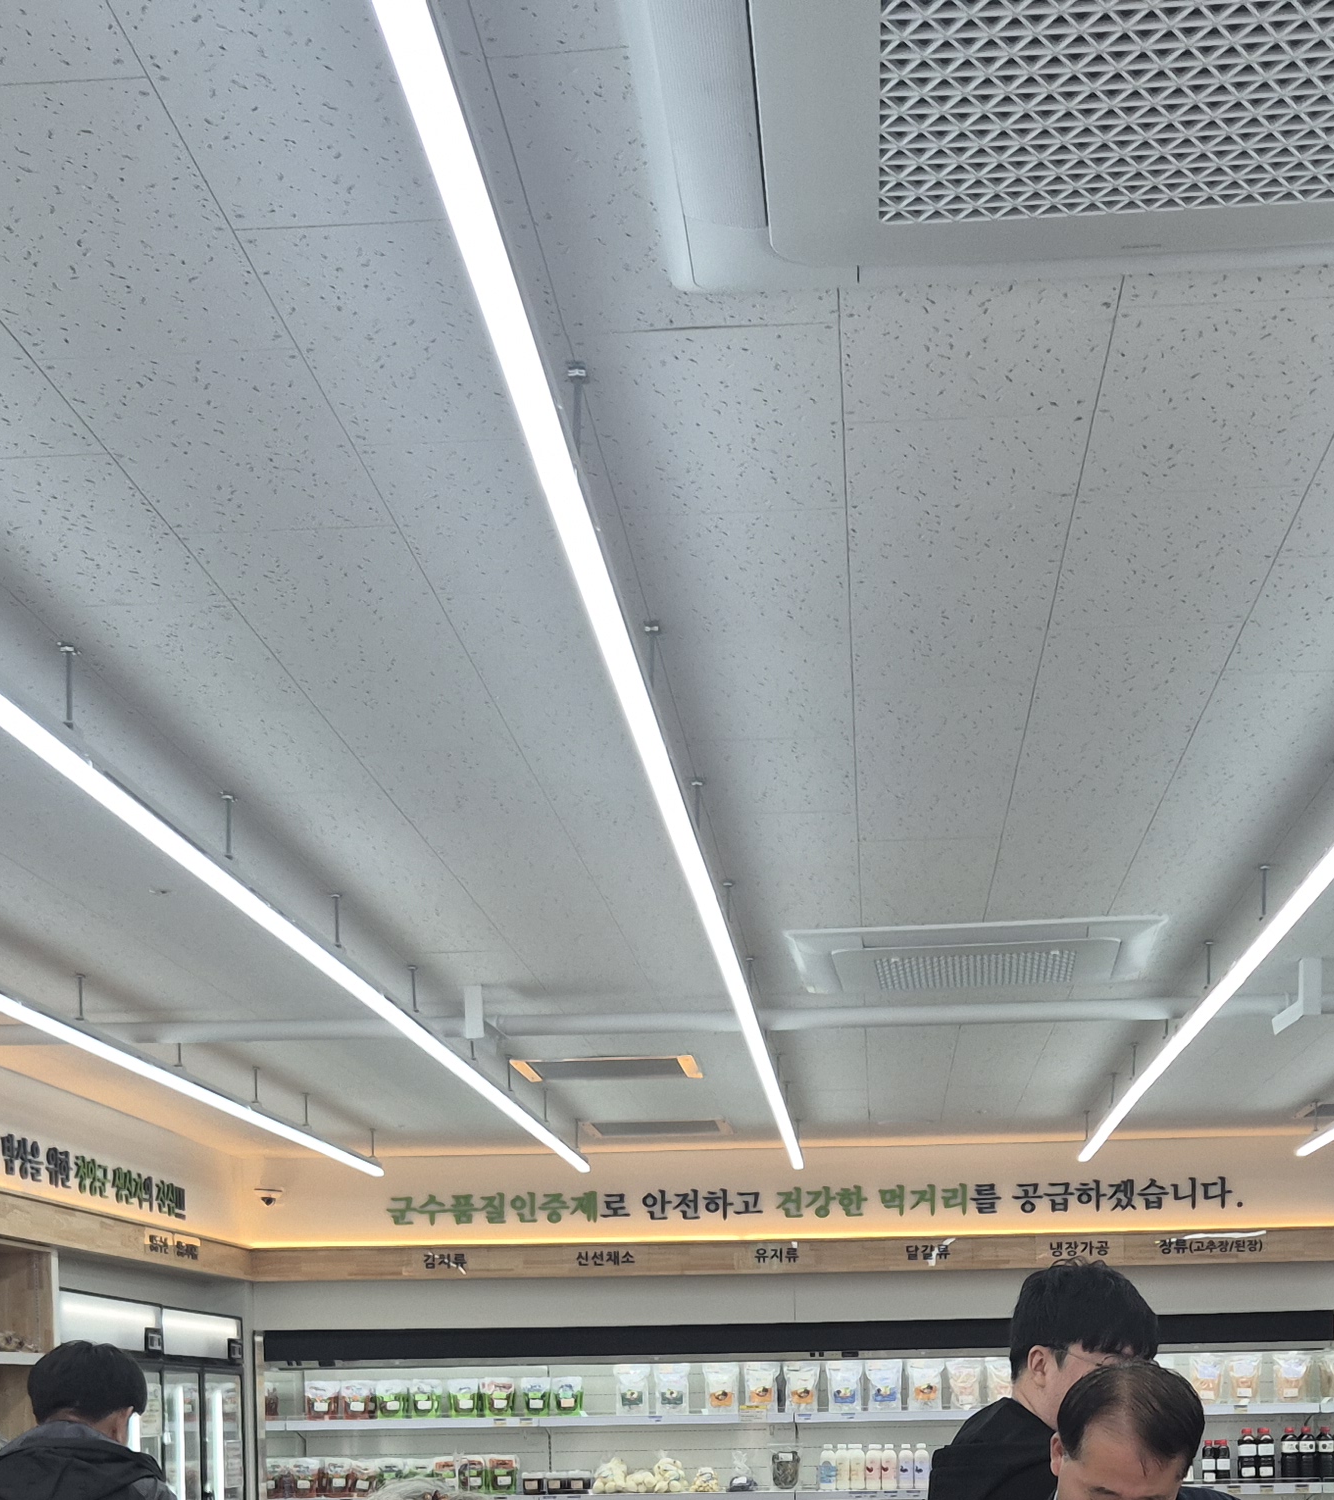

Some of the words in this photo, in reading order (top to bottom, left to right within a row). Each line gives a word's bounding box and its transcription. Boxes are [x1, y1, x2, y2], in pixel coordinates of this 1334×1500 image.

[1, 1133, 44, 1183] 밥상을
[45, 1147, 73, 1190] 위한
[74, 1155, 111, 1199] 청양군
[386, 1189, 632, 1226] 군수품질인증제로
[641, 1187, 764, 1222] 안전하고
[775, 1183, 868, 1219] 건강한
[878, 1182, 999, 1217] 먹거리를
[1012, 1175, 1245, 1213] 공급하겠습니다.
[1049, 1239, 1111, 1258] 냉장가공
[423, 1252, 468, 1271] 김치류
[576, 1249, 636, 1268] 신선채소
